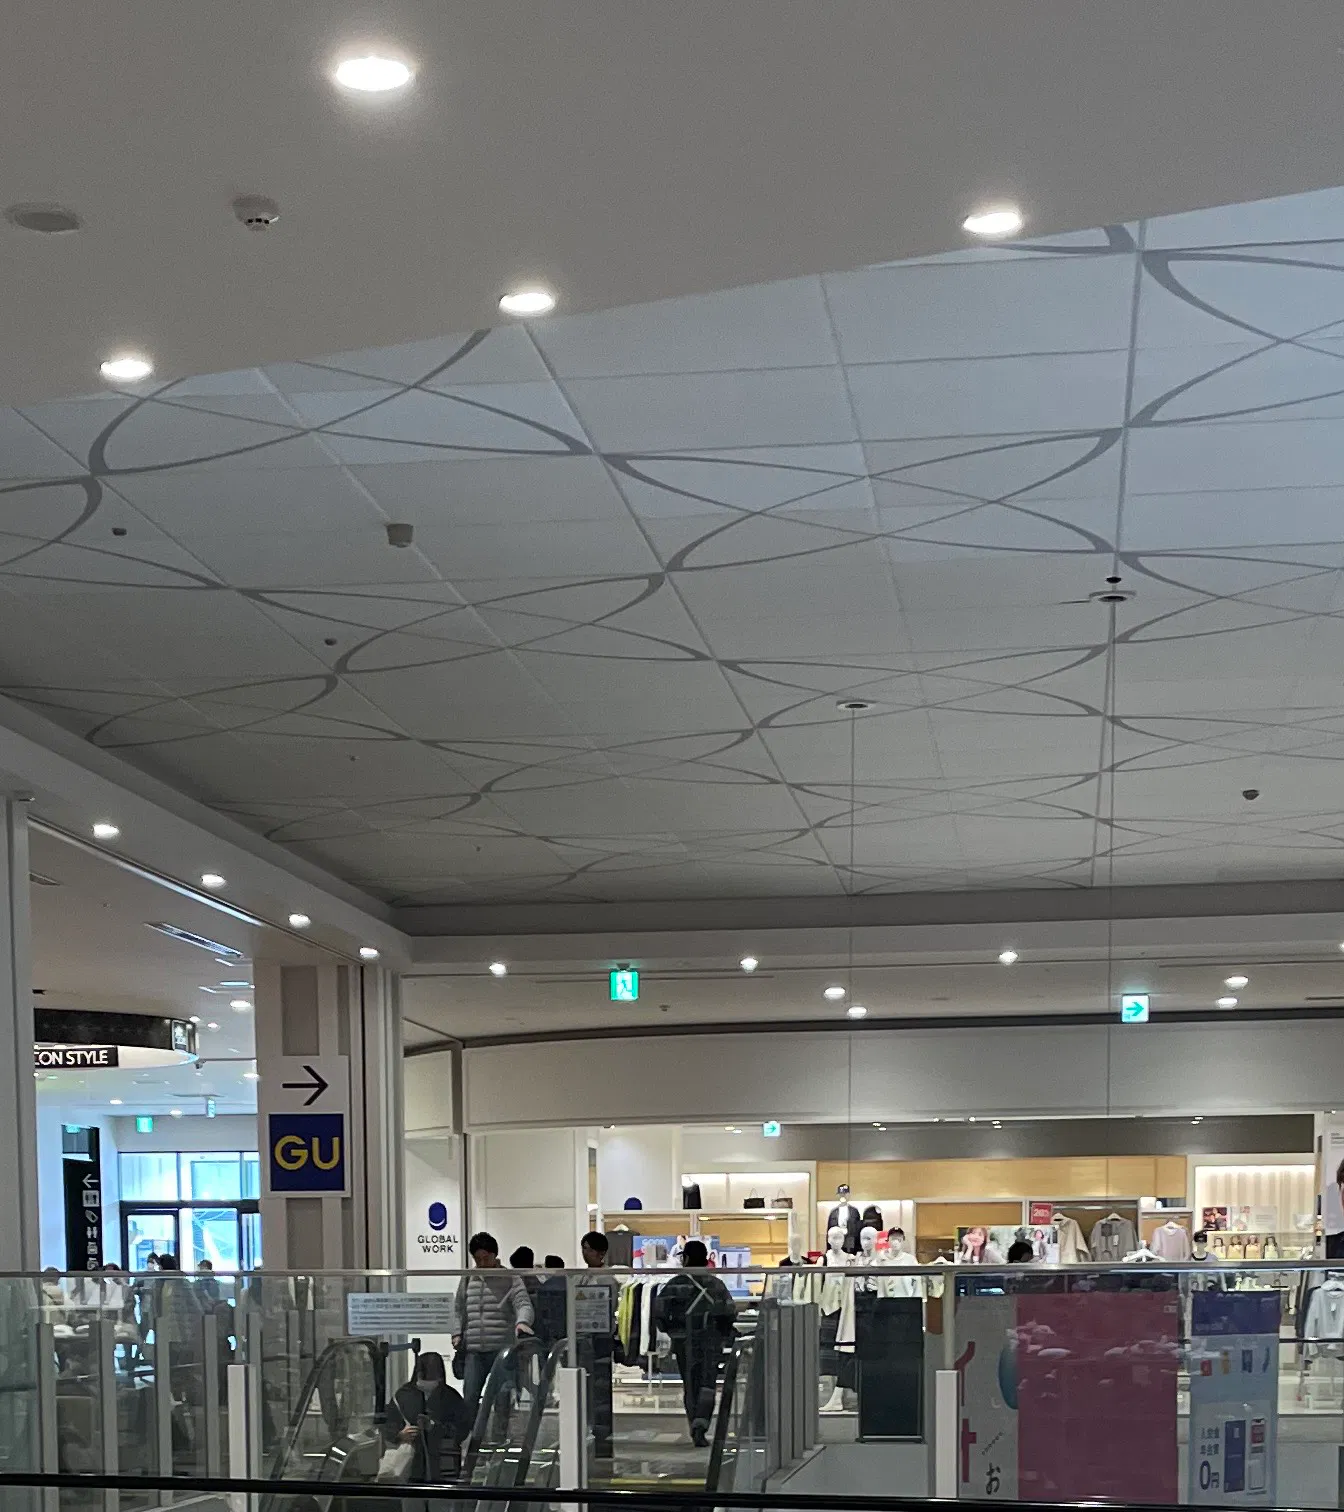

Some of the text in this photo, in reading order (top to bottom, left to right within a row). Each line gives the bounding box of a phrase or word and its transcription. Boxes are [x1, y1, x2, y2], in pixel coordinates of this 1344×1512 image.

[66, 1050, 108, 1066] STYLE
[274, 1135, 341, 1171] GU
[417, 1235, 459, 1244] GLOBAL
[421, 1245, 454, 1253] WORK
[1199, 1460, 1220, 1490] 0円
